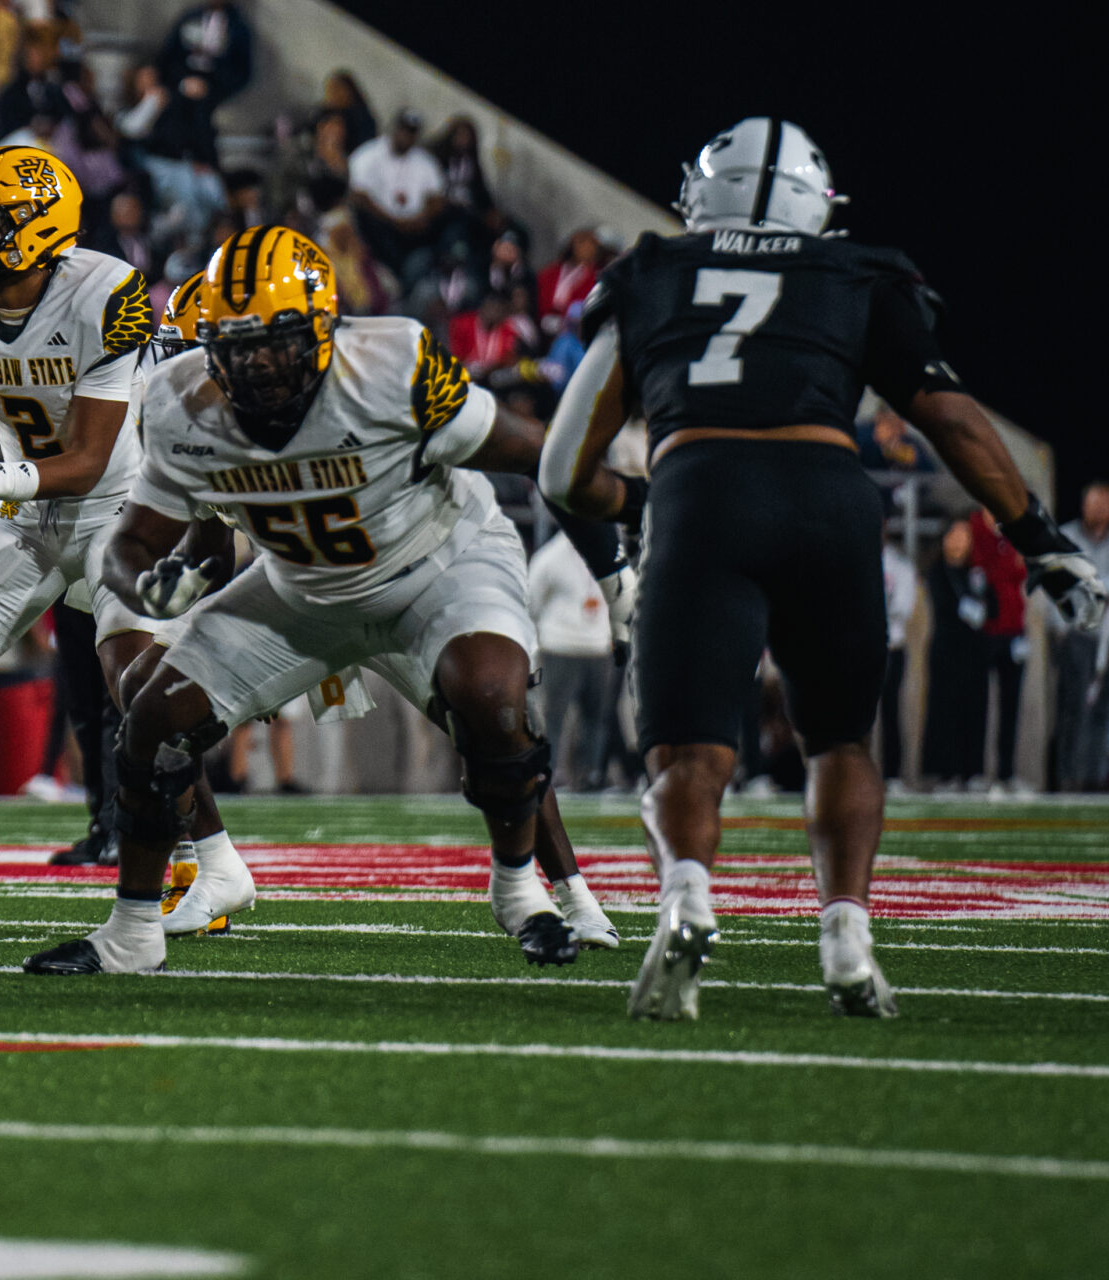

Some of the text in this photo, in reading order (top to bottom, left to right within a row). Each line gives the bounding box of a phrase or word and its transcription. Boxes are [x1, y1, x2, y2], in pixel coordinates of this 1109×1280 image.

[712, 230, 802, 254] WALKER
[688, 268, 783, 387] 7
[27, 356, 77, 386] STATE
[308, 454, 368, 490] STATE
[245, 495, 377, 566] 56
